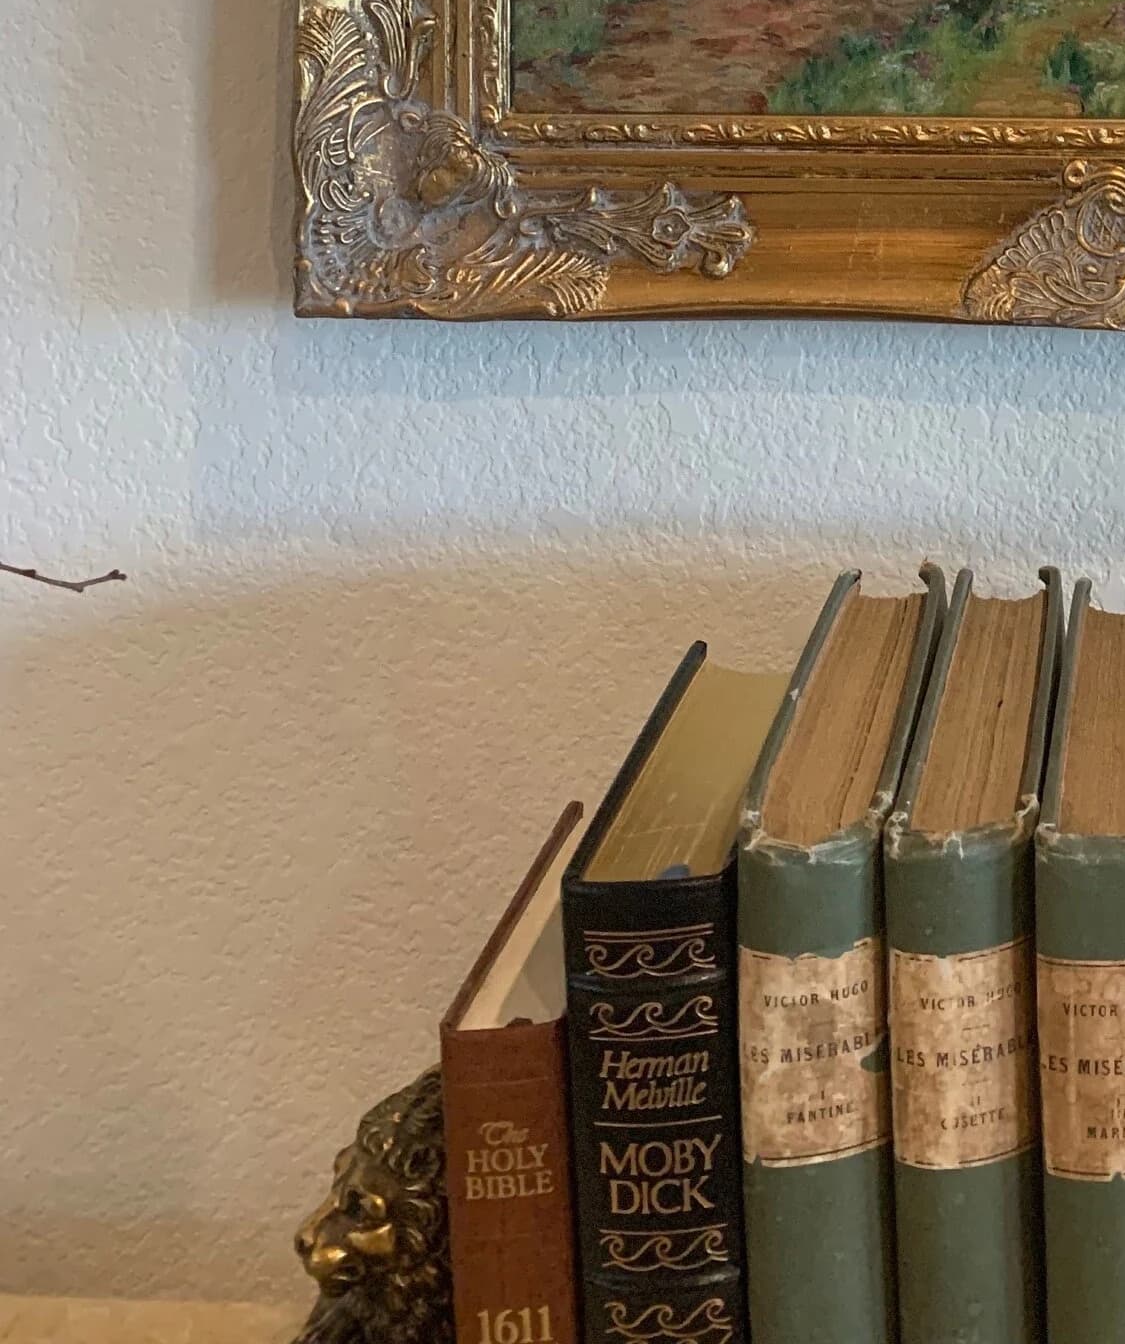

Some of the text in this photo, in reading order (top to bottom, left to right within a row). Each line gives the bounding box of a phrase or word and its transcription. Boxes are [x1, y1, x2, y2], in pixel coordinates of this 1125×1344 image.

[764, 979, 869, 1008] VICTOR HUGO
[920, 981, 1023, 1011] VICOR HUGO
[1062, 1001, 1118, 1017] VICTOR
[600, 1050, 709, 1080] Herman
[743, 1042, 770, 1065] ES
[896, 1035, 1026, 1069] LES MISÉRABL
[1043, 1054, 1069, 1074] ES
[601, 1076, 707, 1110] Melville
[479, 1120, 530, 1145] The
[941, 1107, 1006, 1131] COSETTE
[467, 1143, 549, 1173] HOLY
[600, 1133, 723, 1177] MOBY
[465, 1169, 554, 1200] BIBLE
[609, 1174, 715, 1215] DICK
[477, 1304, 556, 1344] 1611
